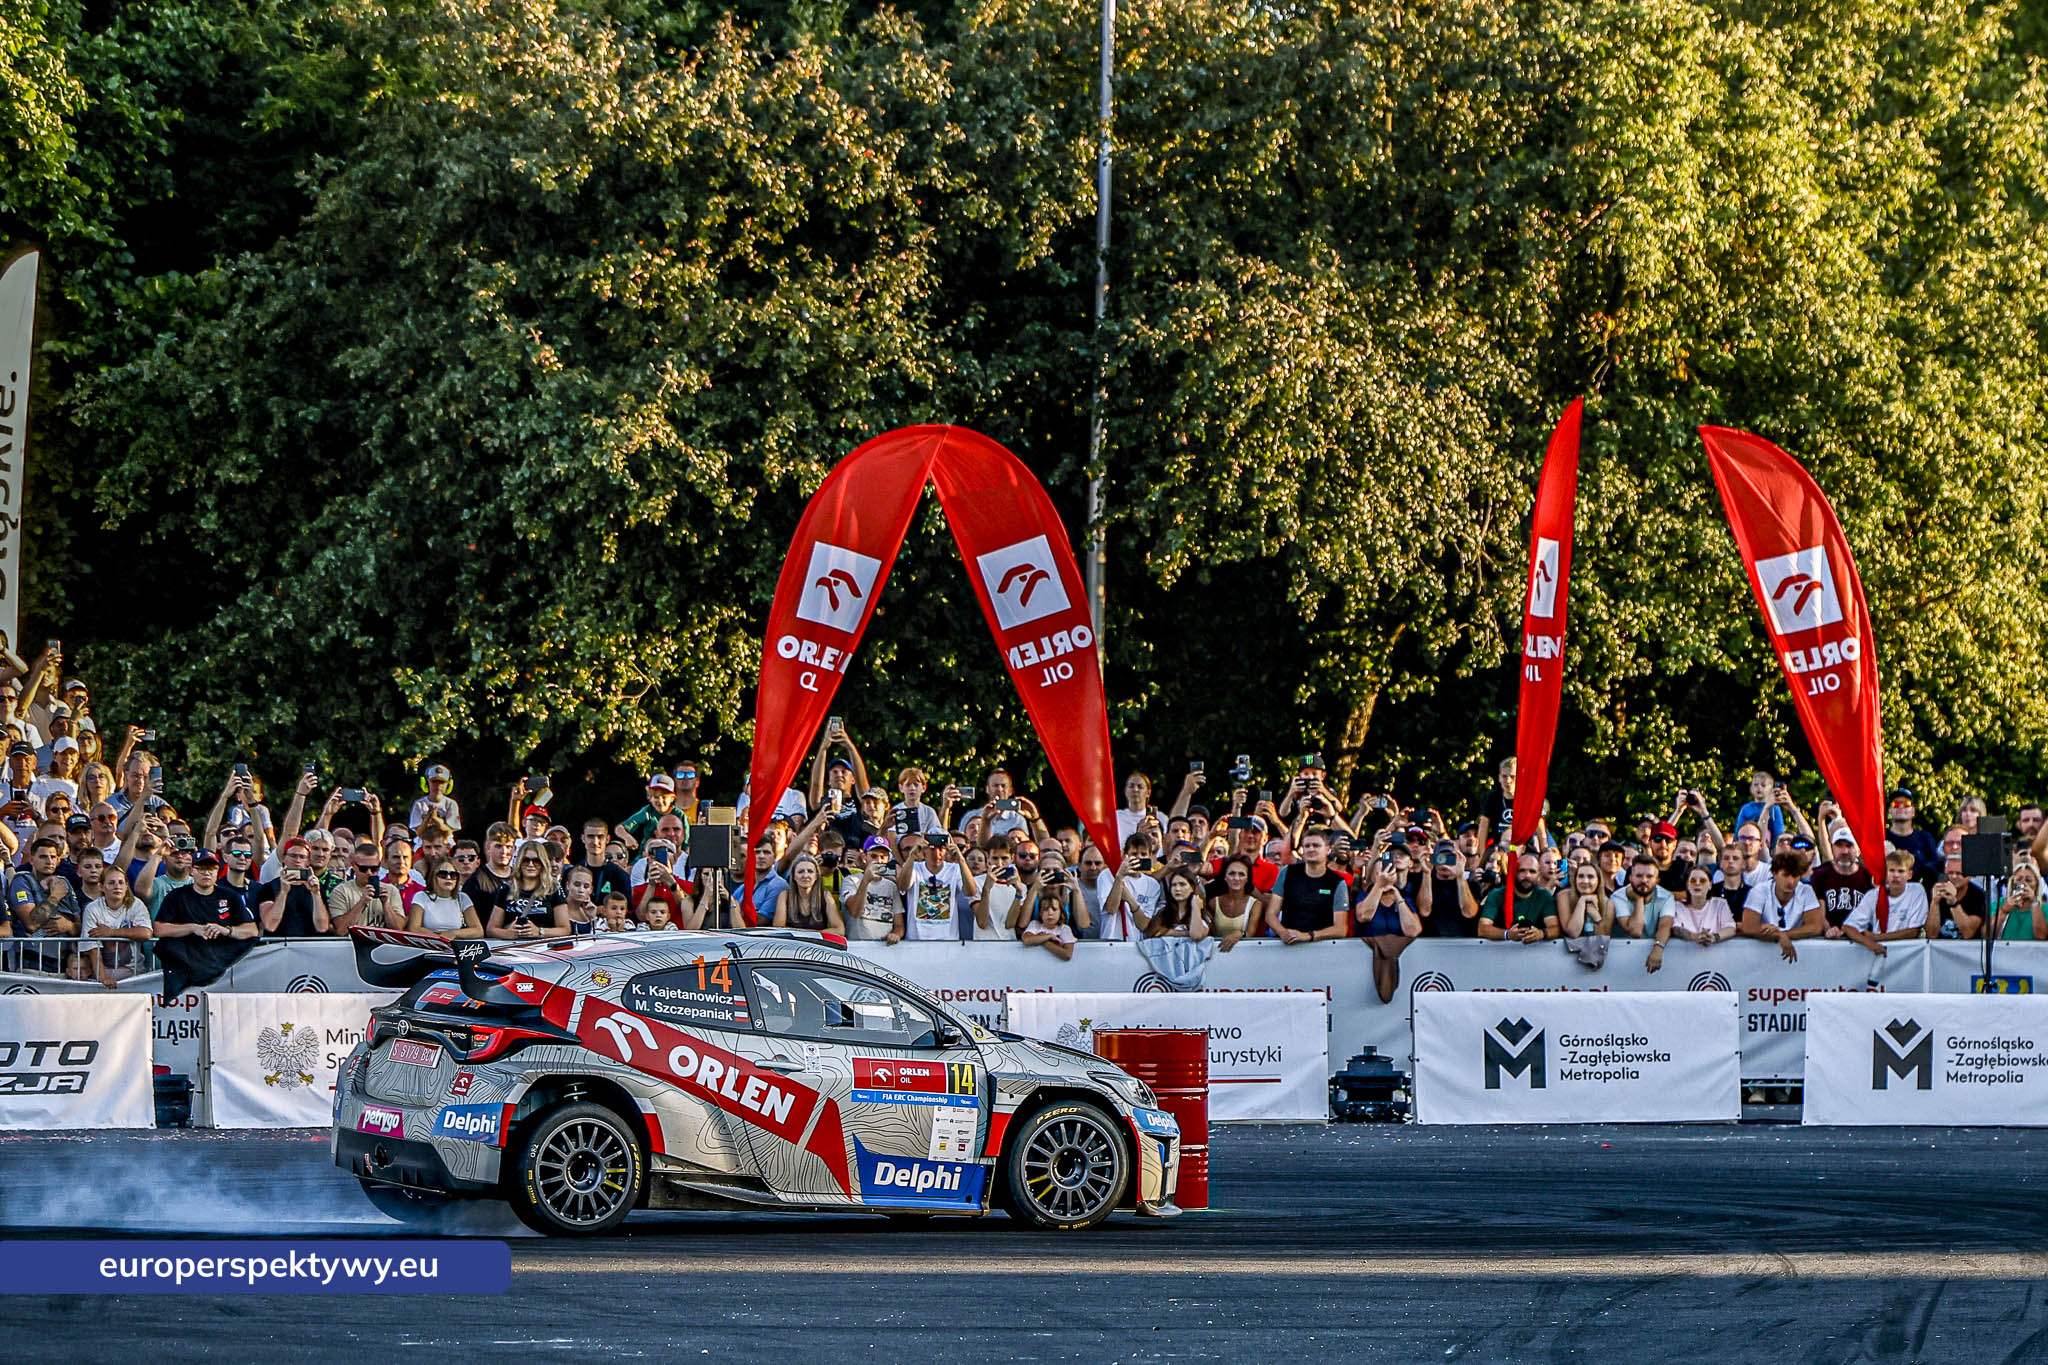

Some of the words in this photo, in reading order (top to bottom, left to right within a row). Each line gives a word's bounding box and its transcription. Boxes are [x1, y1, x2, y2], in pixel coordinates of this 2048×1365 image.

[692, 955, 733, 993] 14
[516, 983, 535, 992] OMP
[632, 983, 646, 996] K.
[649, 984, 734, 1005] Kajetanowicz
[635, 999, 651, 1012] M.
[654, 1000, 733, 1022] Szczepaniak
[1559, 1033, 1649, 1052] Górnośląsko
[1946, 1036, 2035, 1053] Górnośląsko
[1947, 1053, 2048, 1070] -Zagłębiowsk
[899, 1067, 930, 1077] ORLEN
[900, 1076, 913, 1084] OIL
[950, 1063, 975, 1095] 14
[1560, 1067, 1640, 1084] Metropolia
[1946, 1070, 2024, 1087] Metropolia
[668, 1044, 797, 1125] ORLEN
[882, 1093, 893, 1101] FIA
[907, 1094, 949, 1105] Championship
[362, 1109, 400, 1133] petrygo
[443, 1110, 497, 1135] Delphi
[873, 1161, 963, 1193] Delphi
